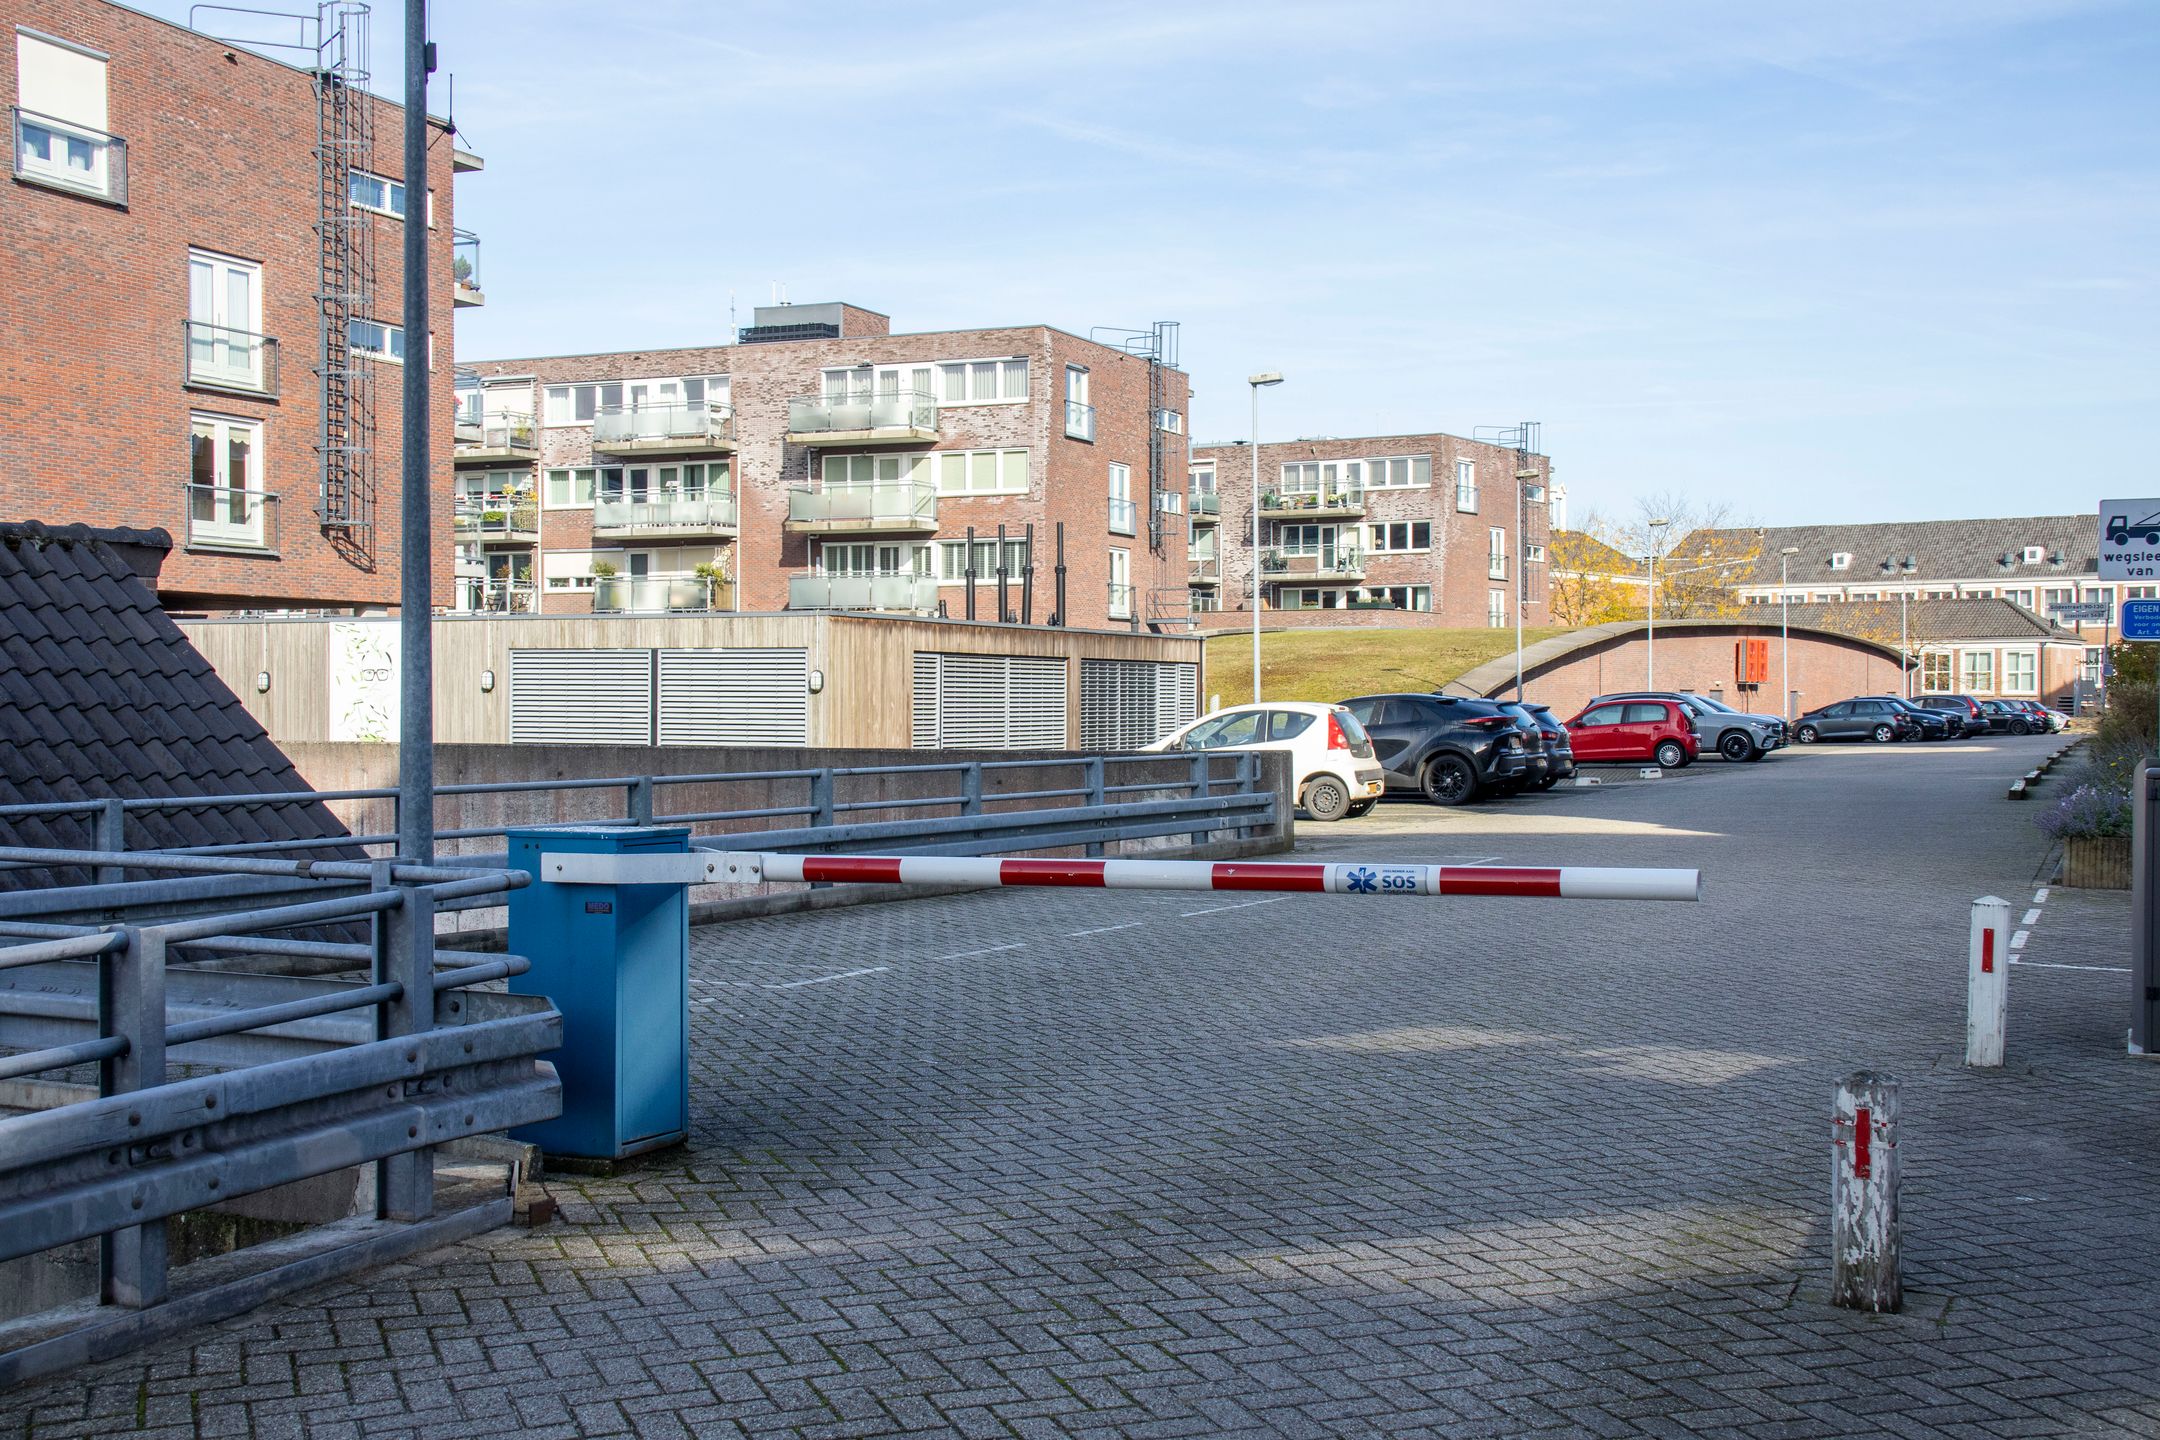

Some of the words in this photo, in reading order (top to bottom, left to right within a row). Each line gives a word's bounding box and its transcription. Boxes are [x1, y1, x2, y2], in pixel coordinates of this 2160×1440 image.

[2127, 567, 2154, 576] van
[2133, 605, 2159, 613] EIGEN
[1382, 875, 1416, 889] SOS
